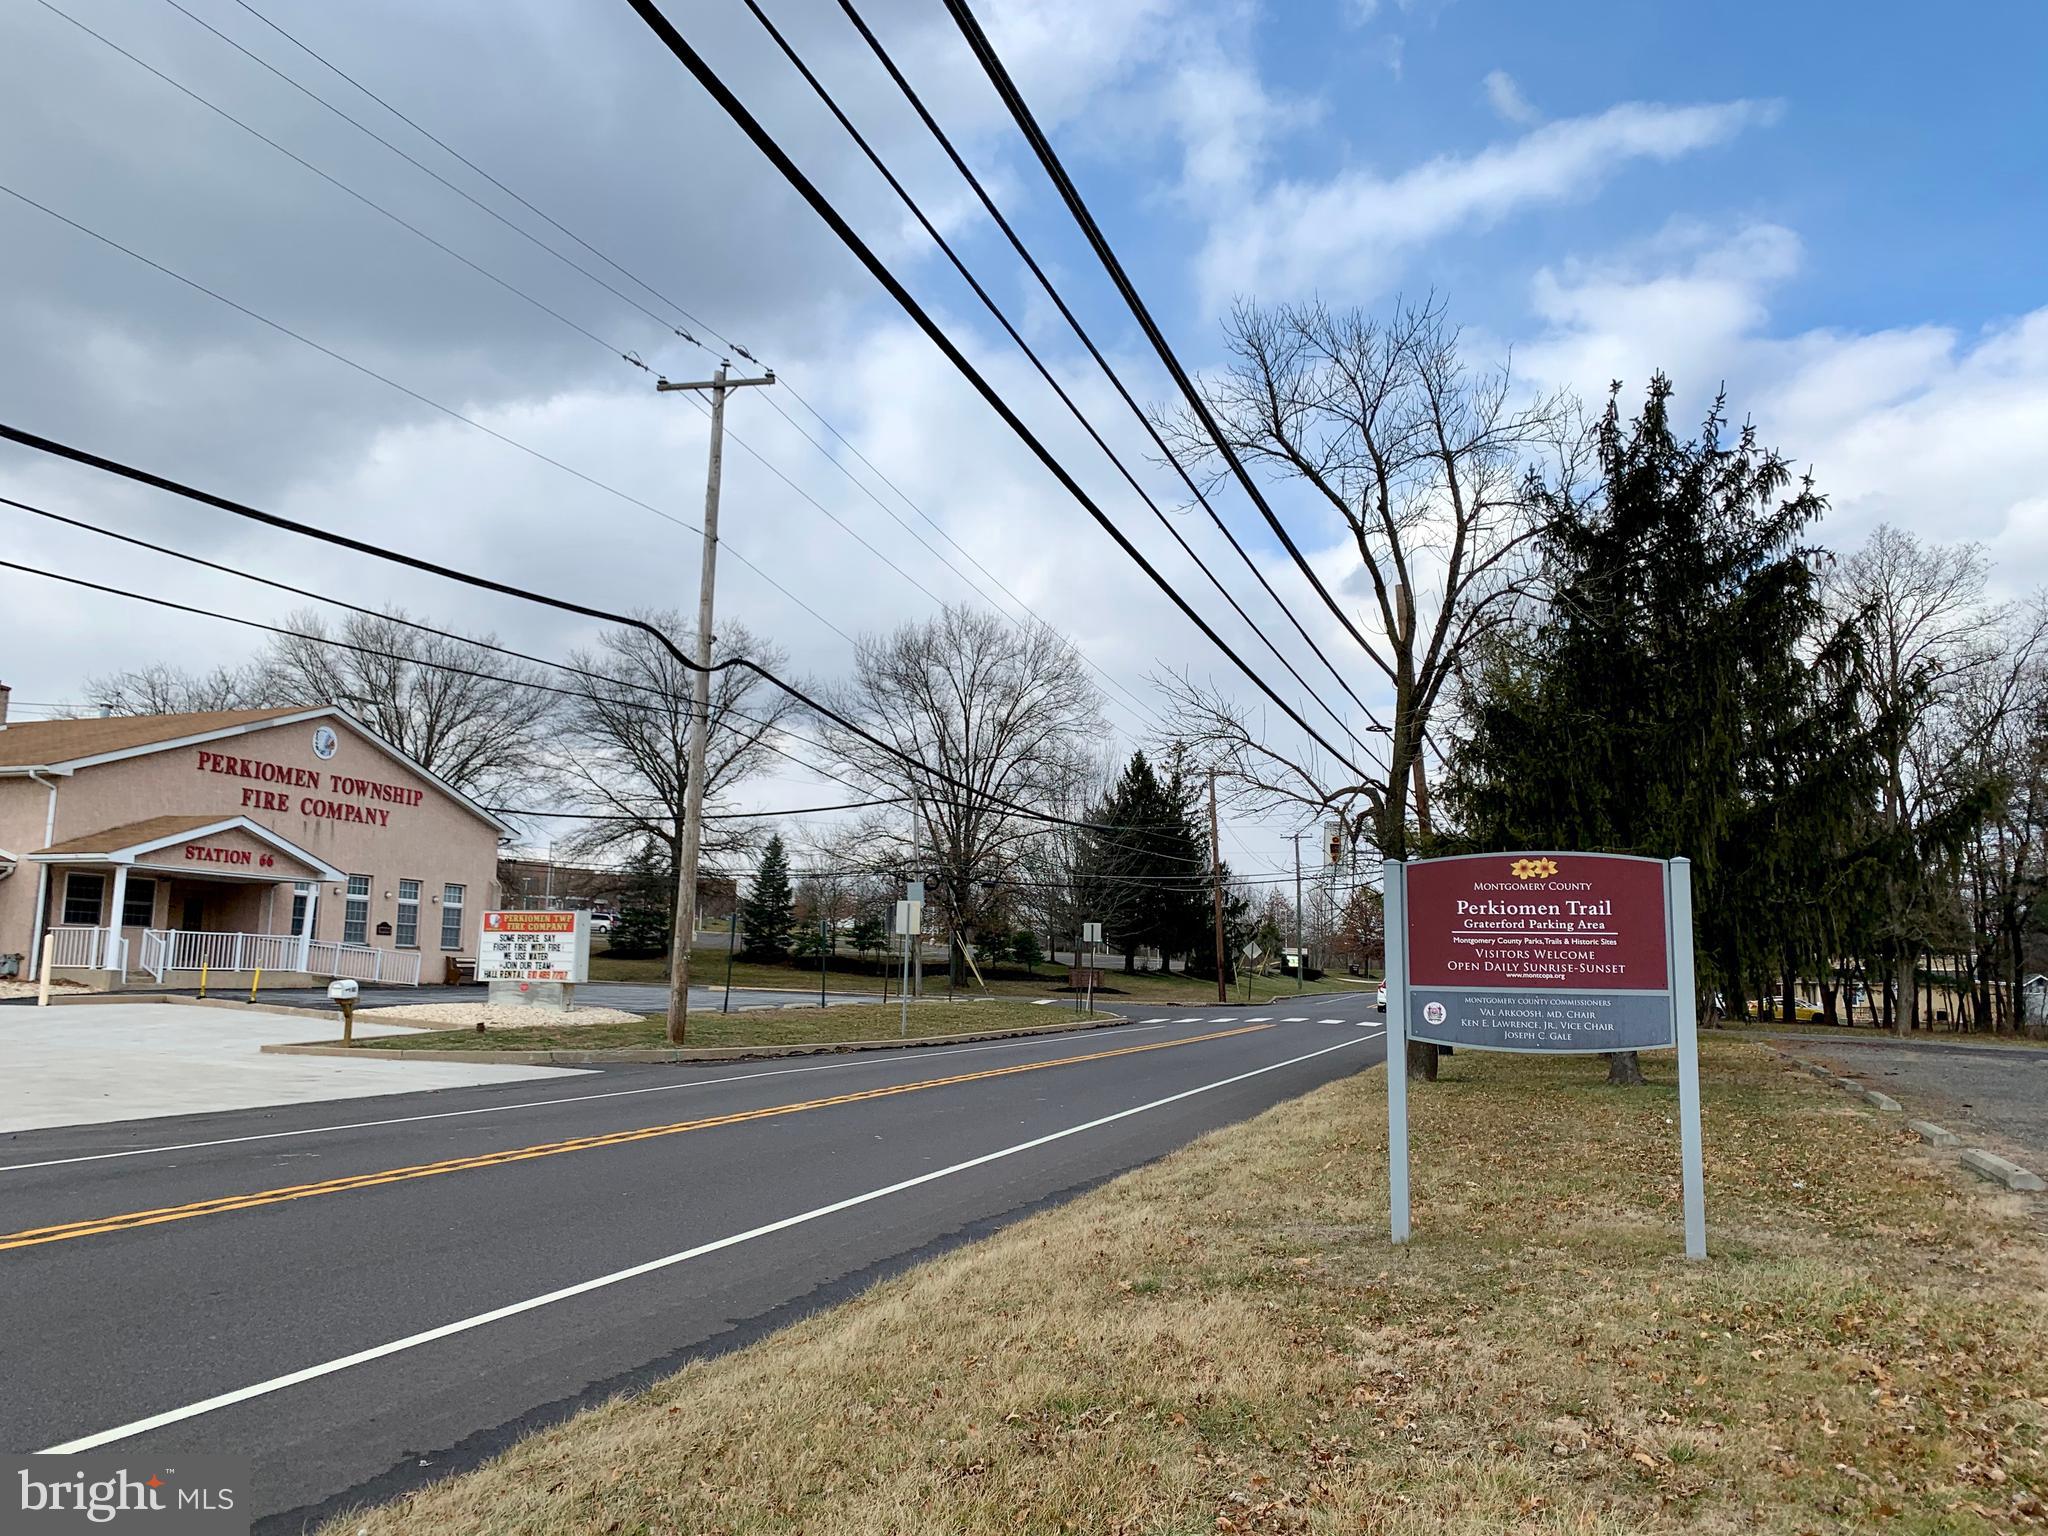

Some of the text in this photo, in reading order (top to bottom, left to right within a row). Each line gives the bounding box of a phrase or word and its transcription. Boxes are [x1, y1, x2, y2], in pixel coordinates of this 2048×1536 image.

[197, 751, 423, 807] PERKIOMEN TOWNSHIP
[241, 788, 390, 827] FIRE COMPANY
[185, 846, 274, 867] STATION 66
[1474, 882, 1592, 891] MONTGOMERY COUNTY
[1457, 900, 1612, 915] Perkiomen Trail
[553, 915, 572, 923] TWP
[528, 923, 569, 931] COMPANY
[1464, 919, 1605, 931] Graterford Parking Area
[1453, 937, 1495, 945] Montgomery
[493, 943, 511, 951] FIGHT
[548, 944, 561, 952] FIRE
[1475, 949, 1595, 960] VISITORS WELCOME
[1448, 961, 1625, 974] OPEN DAILY SUNRISE-SUNSET
[500, 971, 525, 979] RENTAL
[1465, 997, 1516, 1005] MONTGOMERY
[1550, 999, 1611, 1007] COMMISSIONERS
[1480, 1008, 1495, 1016] VAL
[1567, 1011, 1596, 1019] CHAIR
[1461, 1019, 1479, 1027] KEN
[1560, 1022, 1581, 1030] VICE
[1584, 1022, 1614, 1031] CHAIR
[1505, 1032, 1572, 1040] JOSEPH C. GALE
